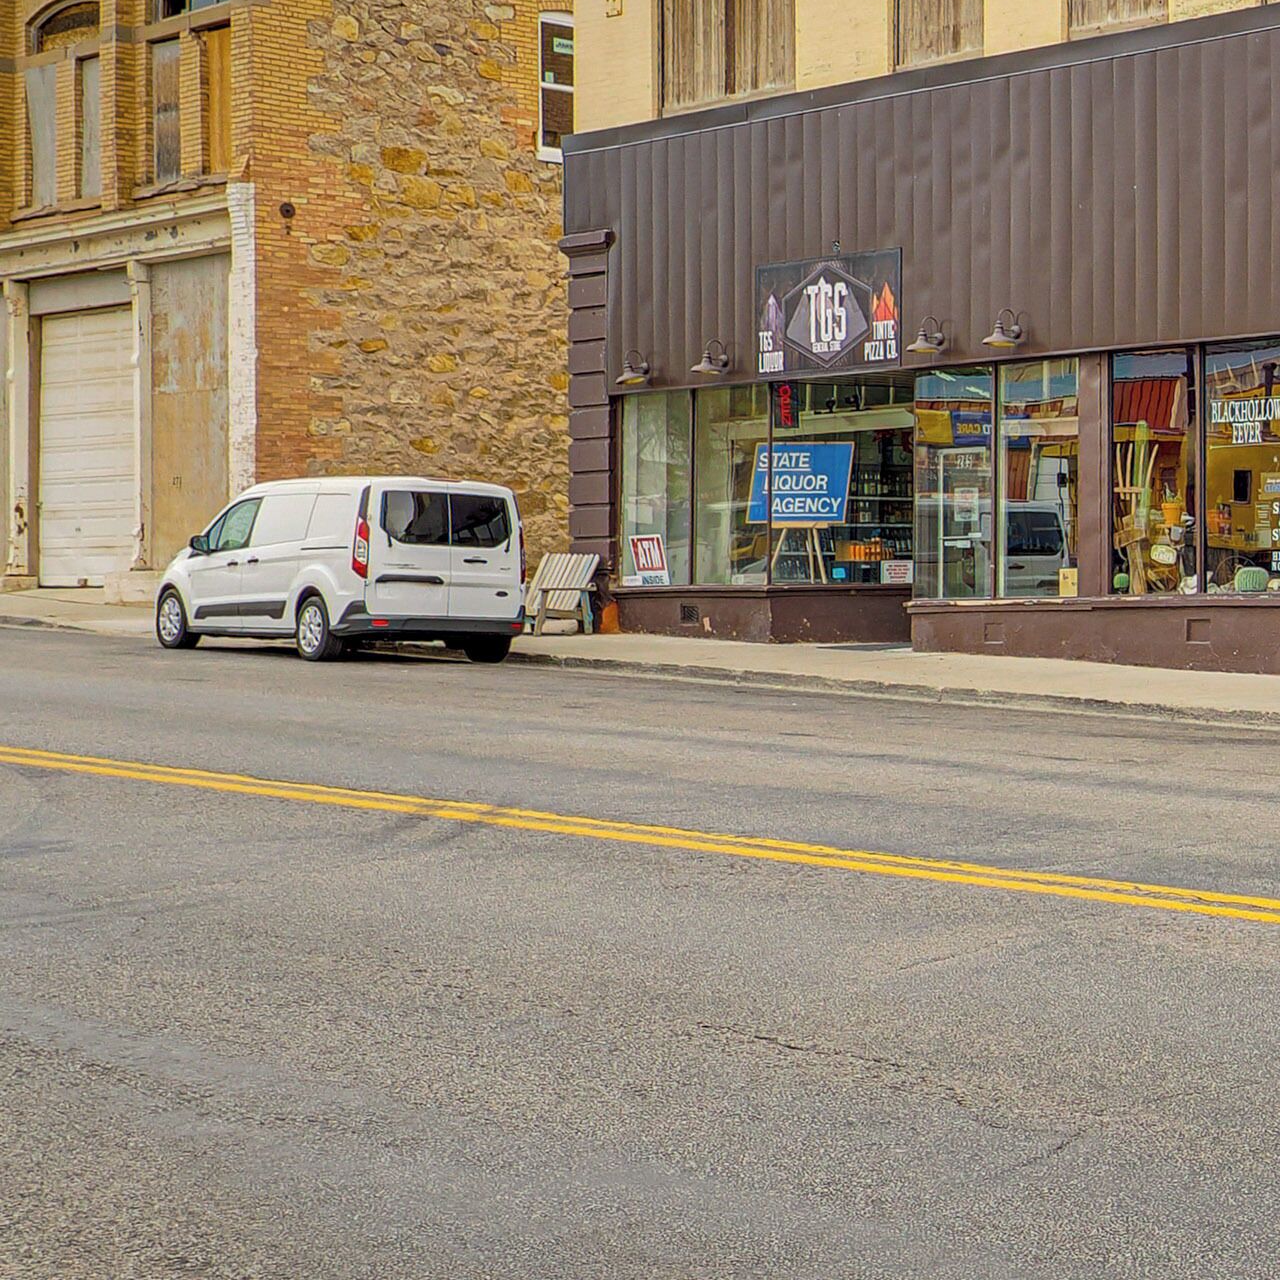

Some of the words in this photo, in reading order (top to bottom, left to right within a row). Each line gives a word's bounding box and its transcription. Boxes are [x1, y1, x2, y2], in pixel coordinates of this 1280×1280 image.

[803, 276, 849, 344] TGS
[758, 331, 774, 353] TGS
[863, 340, 885, 361] PIZZA
[758, 351, 785, 373] LIQUOR
[1232, 422, 1263, 444] FEVER
[758, 452, 811, 468] STATE
[764, 474, 829, 491] LIQUOR
[771, 496, 842, 513] AGENCY
[637, 540, 663, 569] ATM
